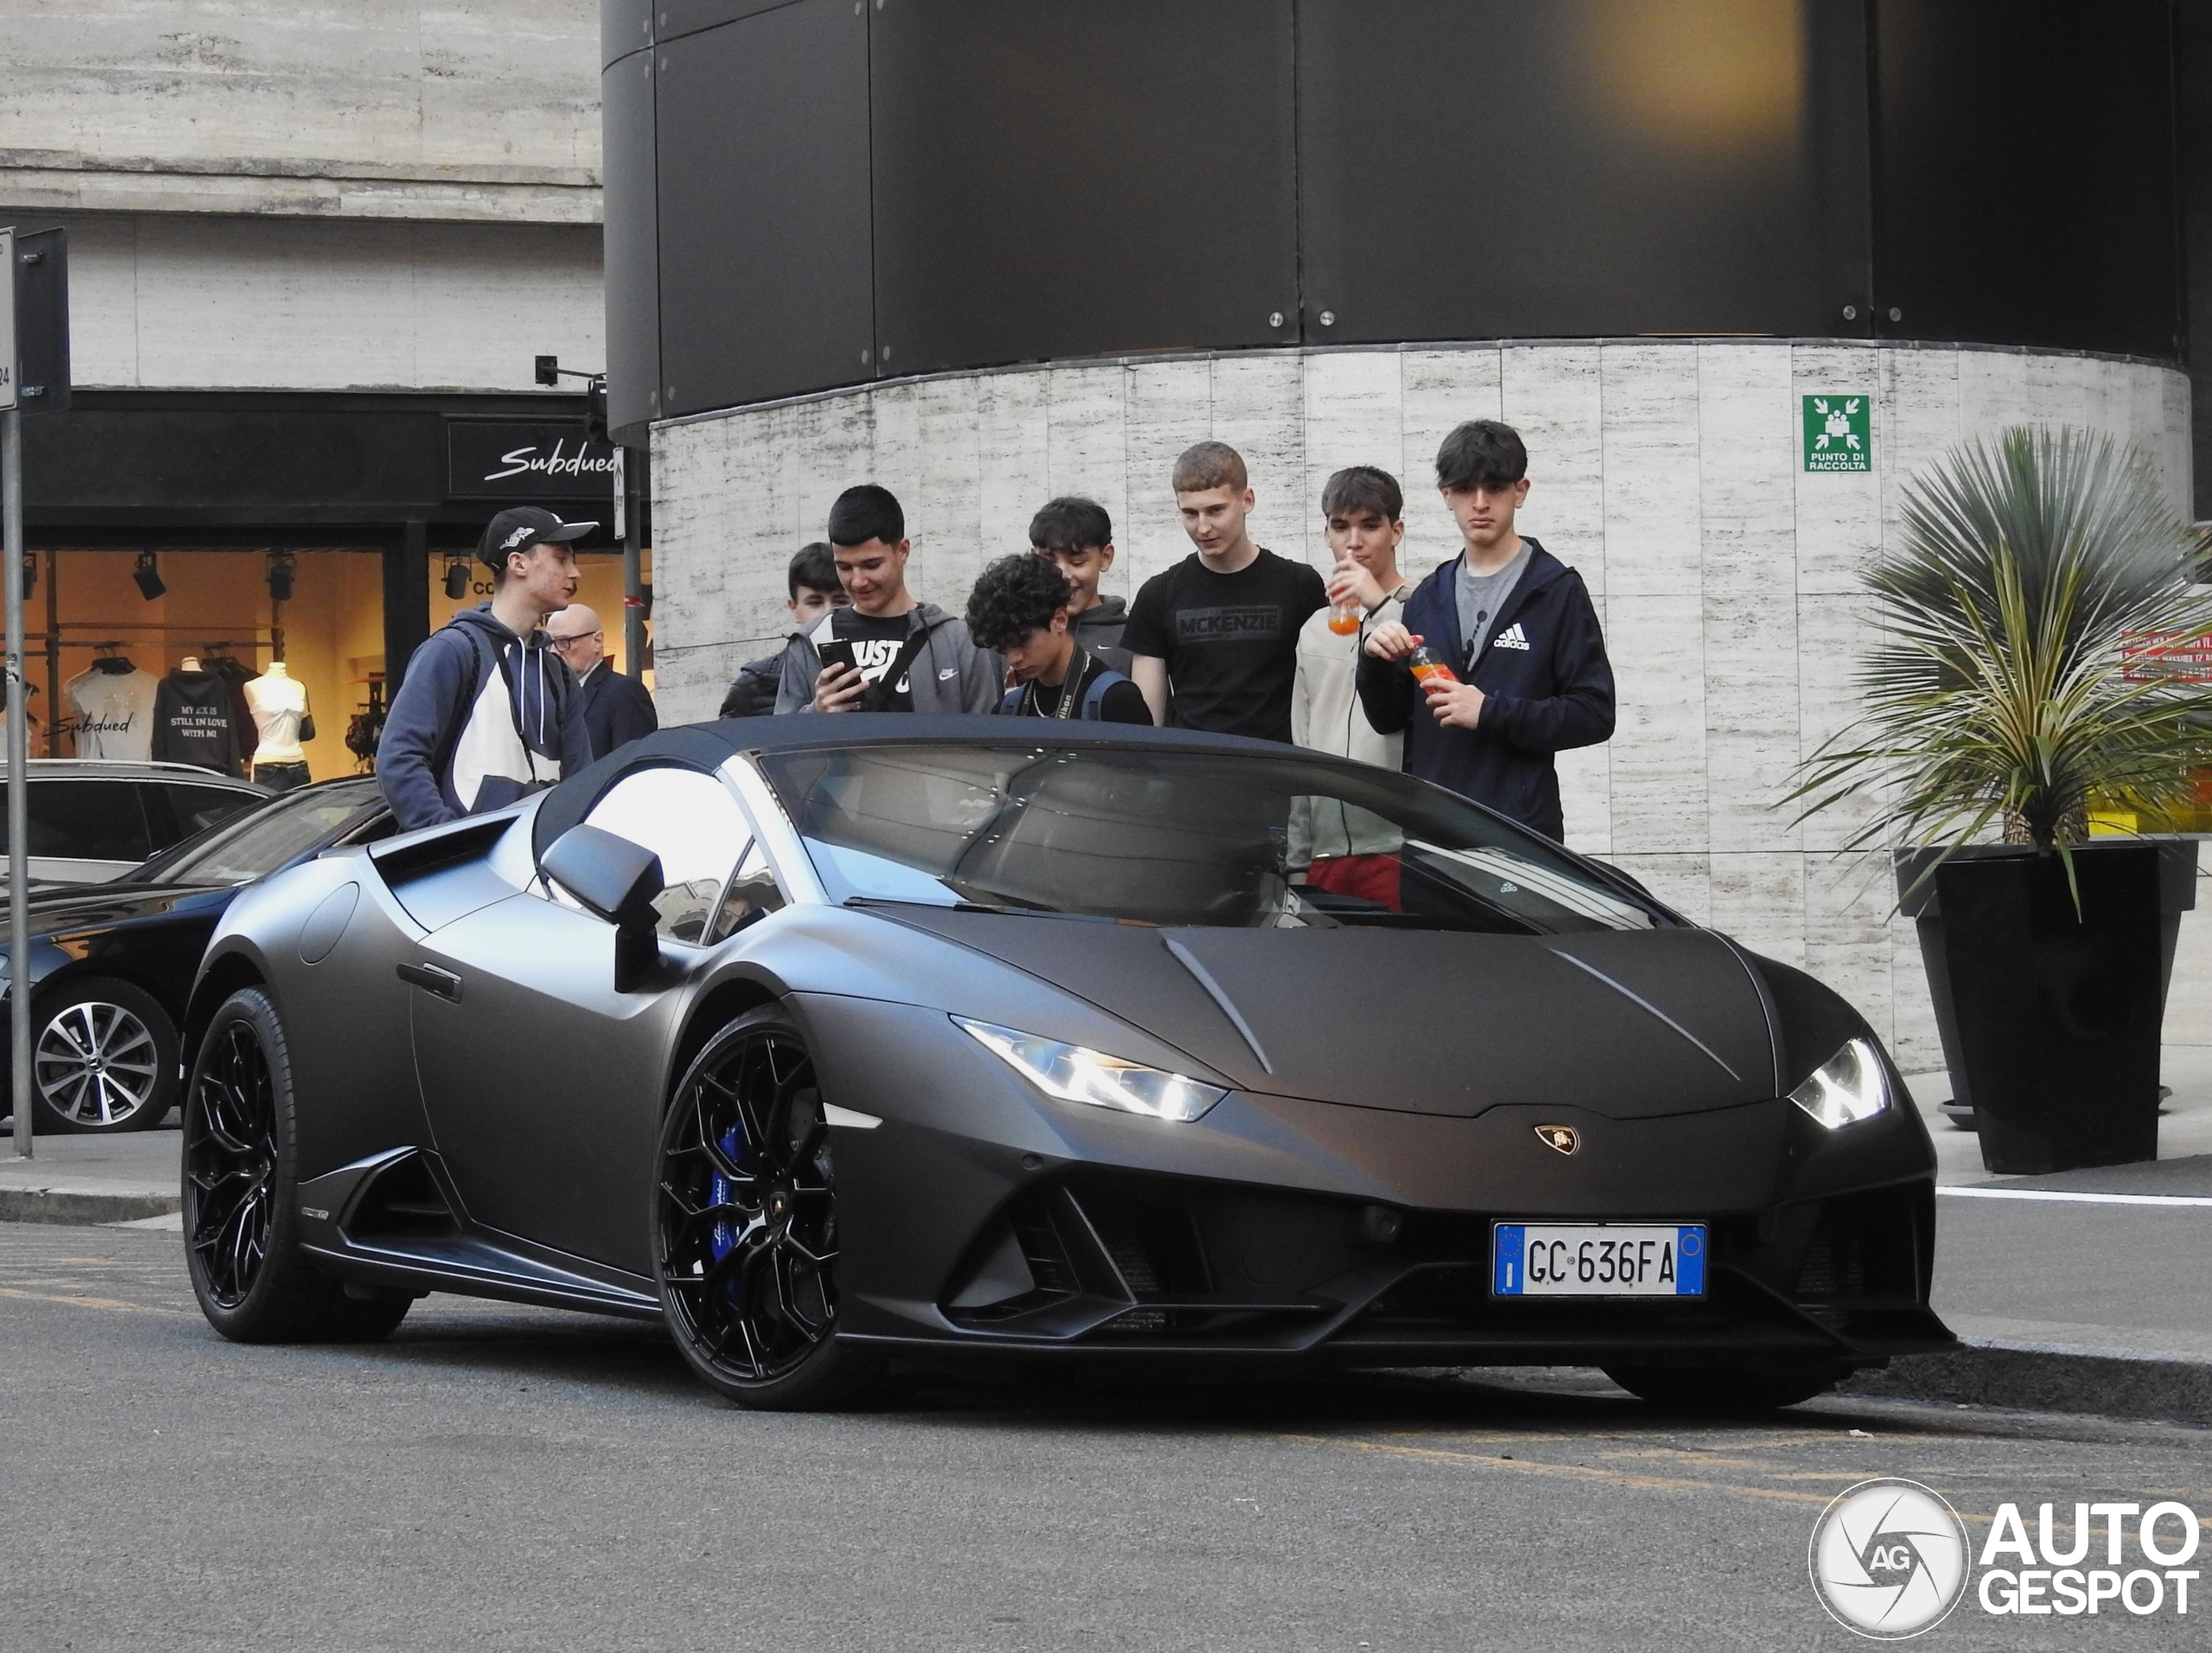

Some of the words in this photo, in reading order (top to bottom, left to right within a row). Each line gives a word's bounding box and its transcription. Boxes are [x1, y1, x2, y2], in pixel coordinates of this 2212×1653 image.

[1811, 453, 1848, 461] PUNTO
[1853, 453, 1865, 461] DI
[1809, 461, 1866, 470] RACCOLTA
[1179, 614, 1279, 635] MCKENZIE
[1493, 639, 1530, 651] adidas
[181, 706, 194, 715] MY
[209, 707, 217, 715] IS
[42, 711, 133, 738] Subdued
[171, 717, 194, 726] STILL
[207, 718, 228, 728] LOVE
[181, 728, 205, 738] WITH
[1529, 1240, 1567, 1282] GC
[1578, 1240, 1675, 1282] 636FA
[1506, 1262, 1513, 1287] I
